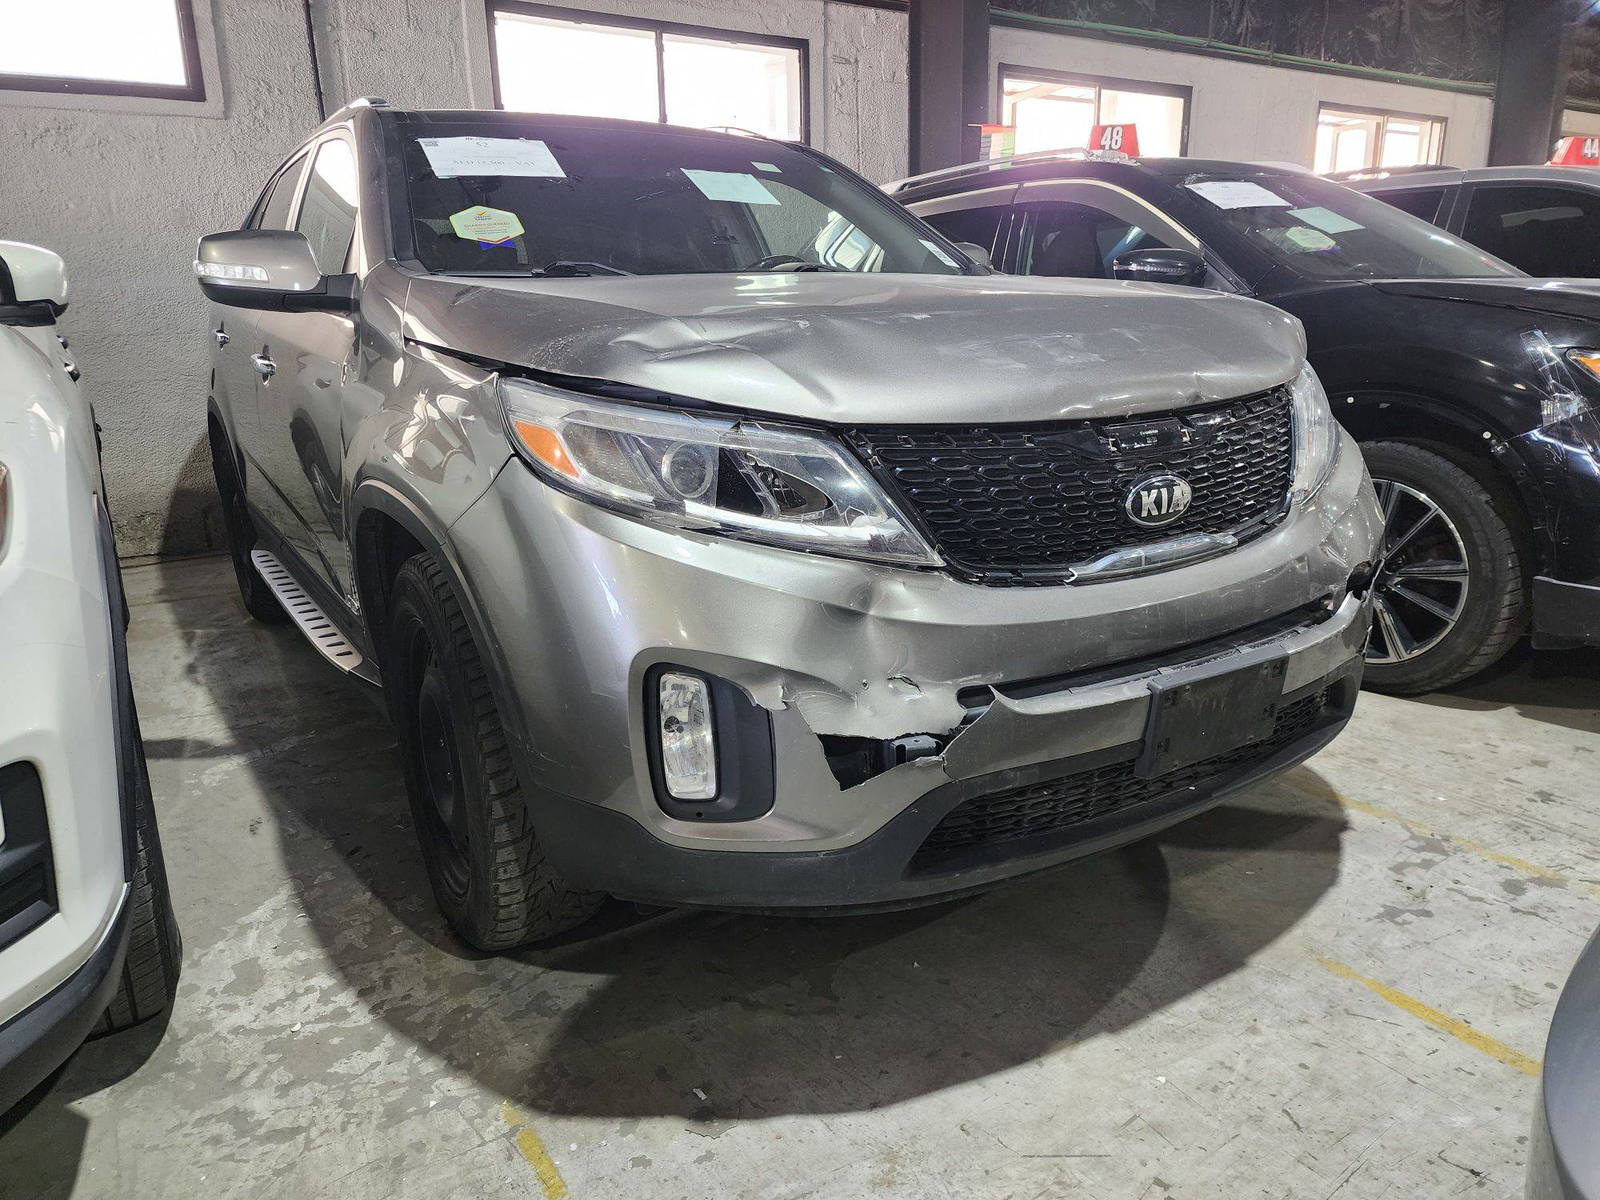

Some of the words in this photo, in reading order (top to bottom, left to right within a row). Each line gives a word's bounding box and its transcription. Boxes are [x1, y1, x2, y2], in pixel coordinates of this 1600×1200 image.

[1100, 126, 1123, 150] 48
[1583, 138, 1600, 158] 44
[1140, 486, 1187, 517] KIA
